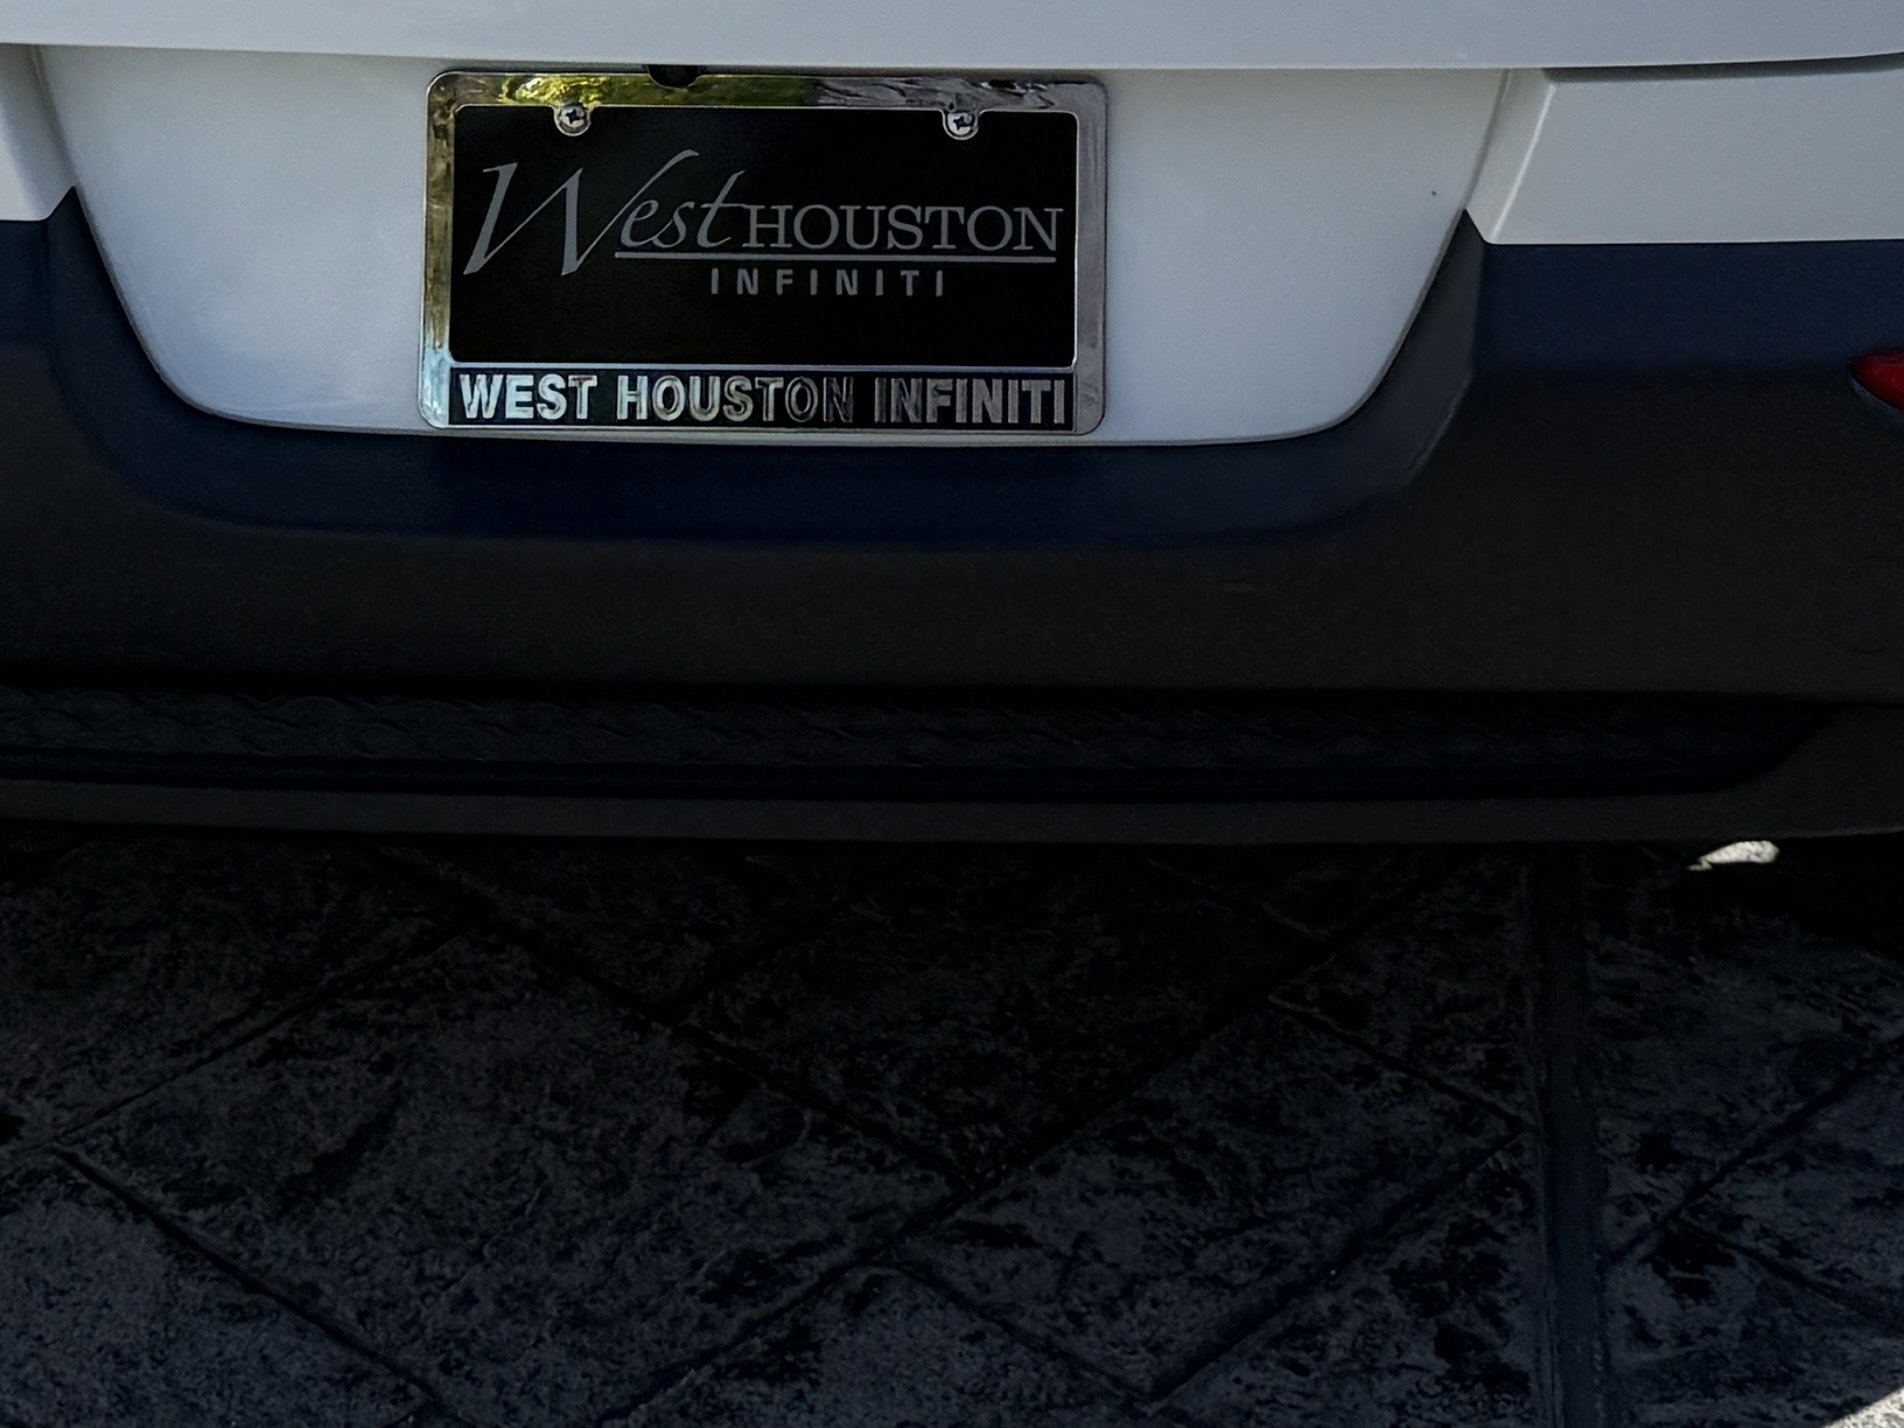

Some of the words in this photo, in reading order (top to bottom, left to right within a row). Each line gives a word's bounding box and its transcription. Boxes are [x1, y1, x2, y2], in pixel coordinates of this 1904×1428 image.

[462, 148, 756, 278] West
[748, 203, 1064, 253] HOUSTON
[711, 267, 945, 297] INFINITI
[459, 372, 598, 422] WEST
[616, 374, 855, 424] HOUSTON
[873, 376, 1067, 426] INFINITI
